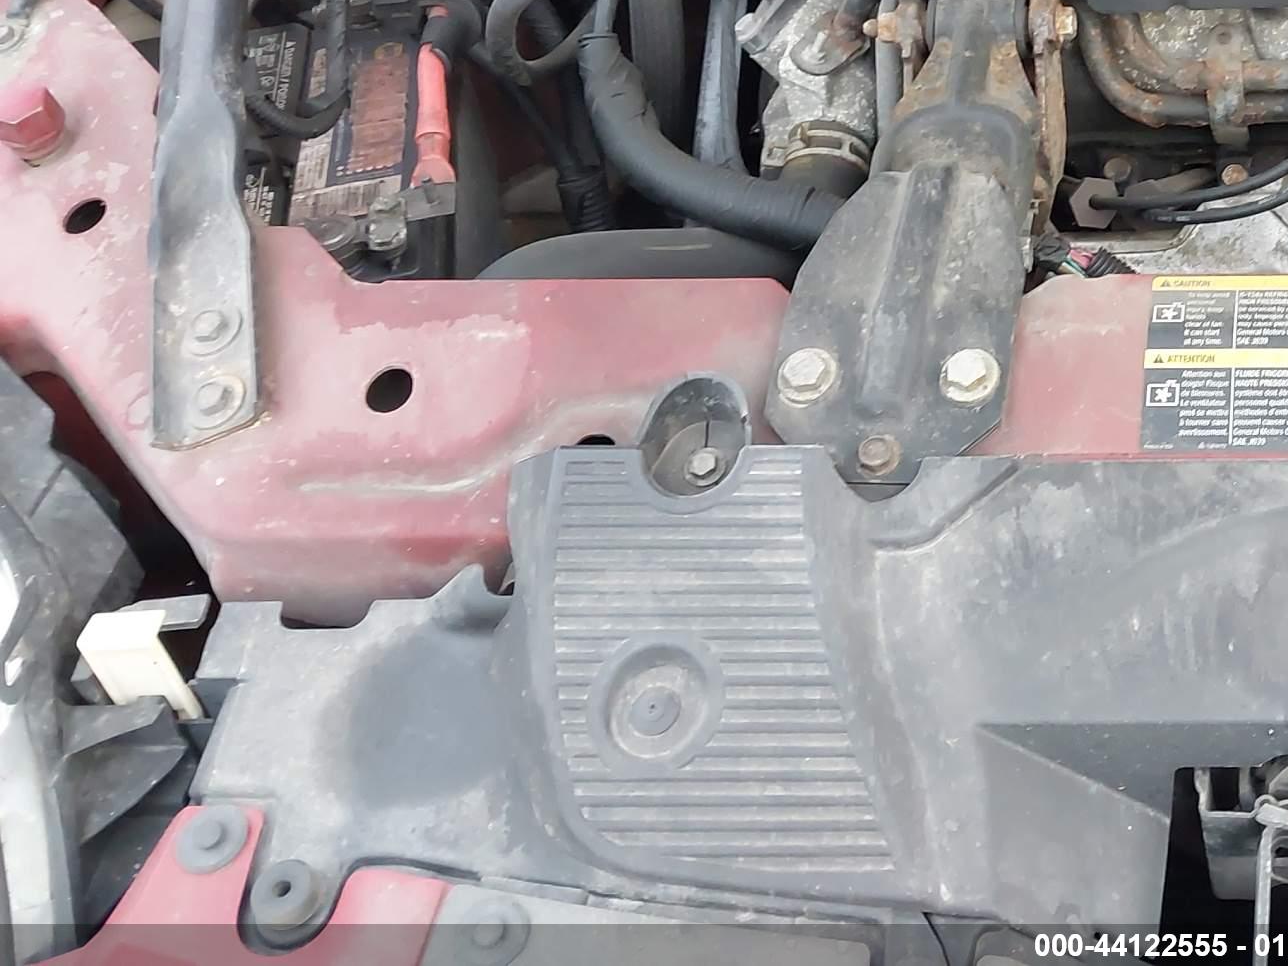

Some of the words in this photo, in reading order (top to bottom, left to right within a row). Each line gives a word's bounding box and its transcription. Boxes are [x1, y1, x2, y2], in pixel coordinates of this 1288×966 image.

[1236, 328, 1262, 336] General
[1262, 328, 1286, 336] Motors
[1192, 338, 1205, 346] any
[1167, 354, 1216, 362] ATTENTION
[1182, 370, 1213, 378] Attention
[1180, 399, 1190, 407] Le
[1233, 428, 1259, 436] General
[1260, 428, 1284, 436] Motors
